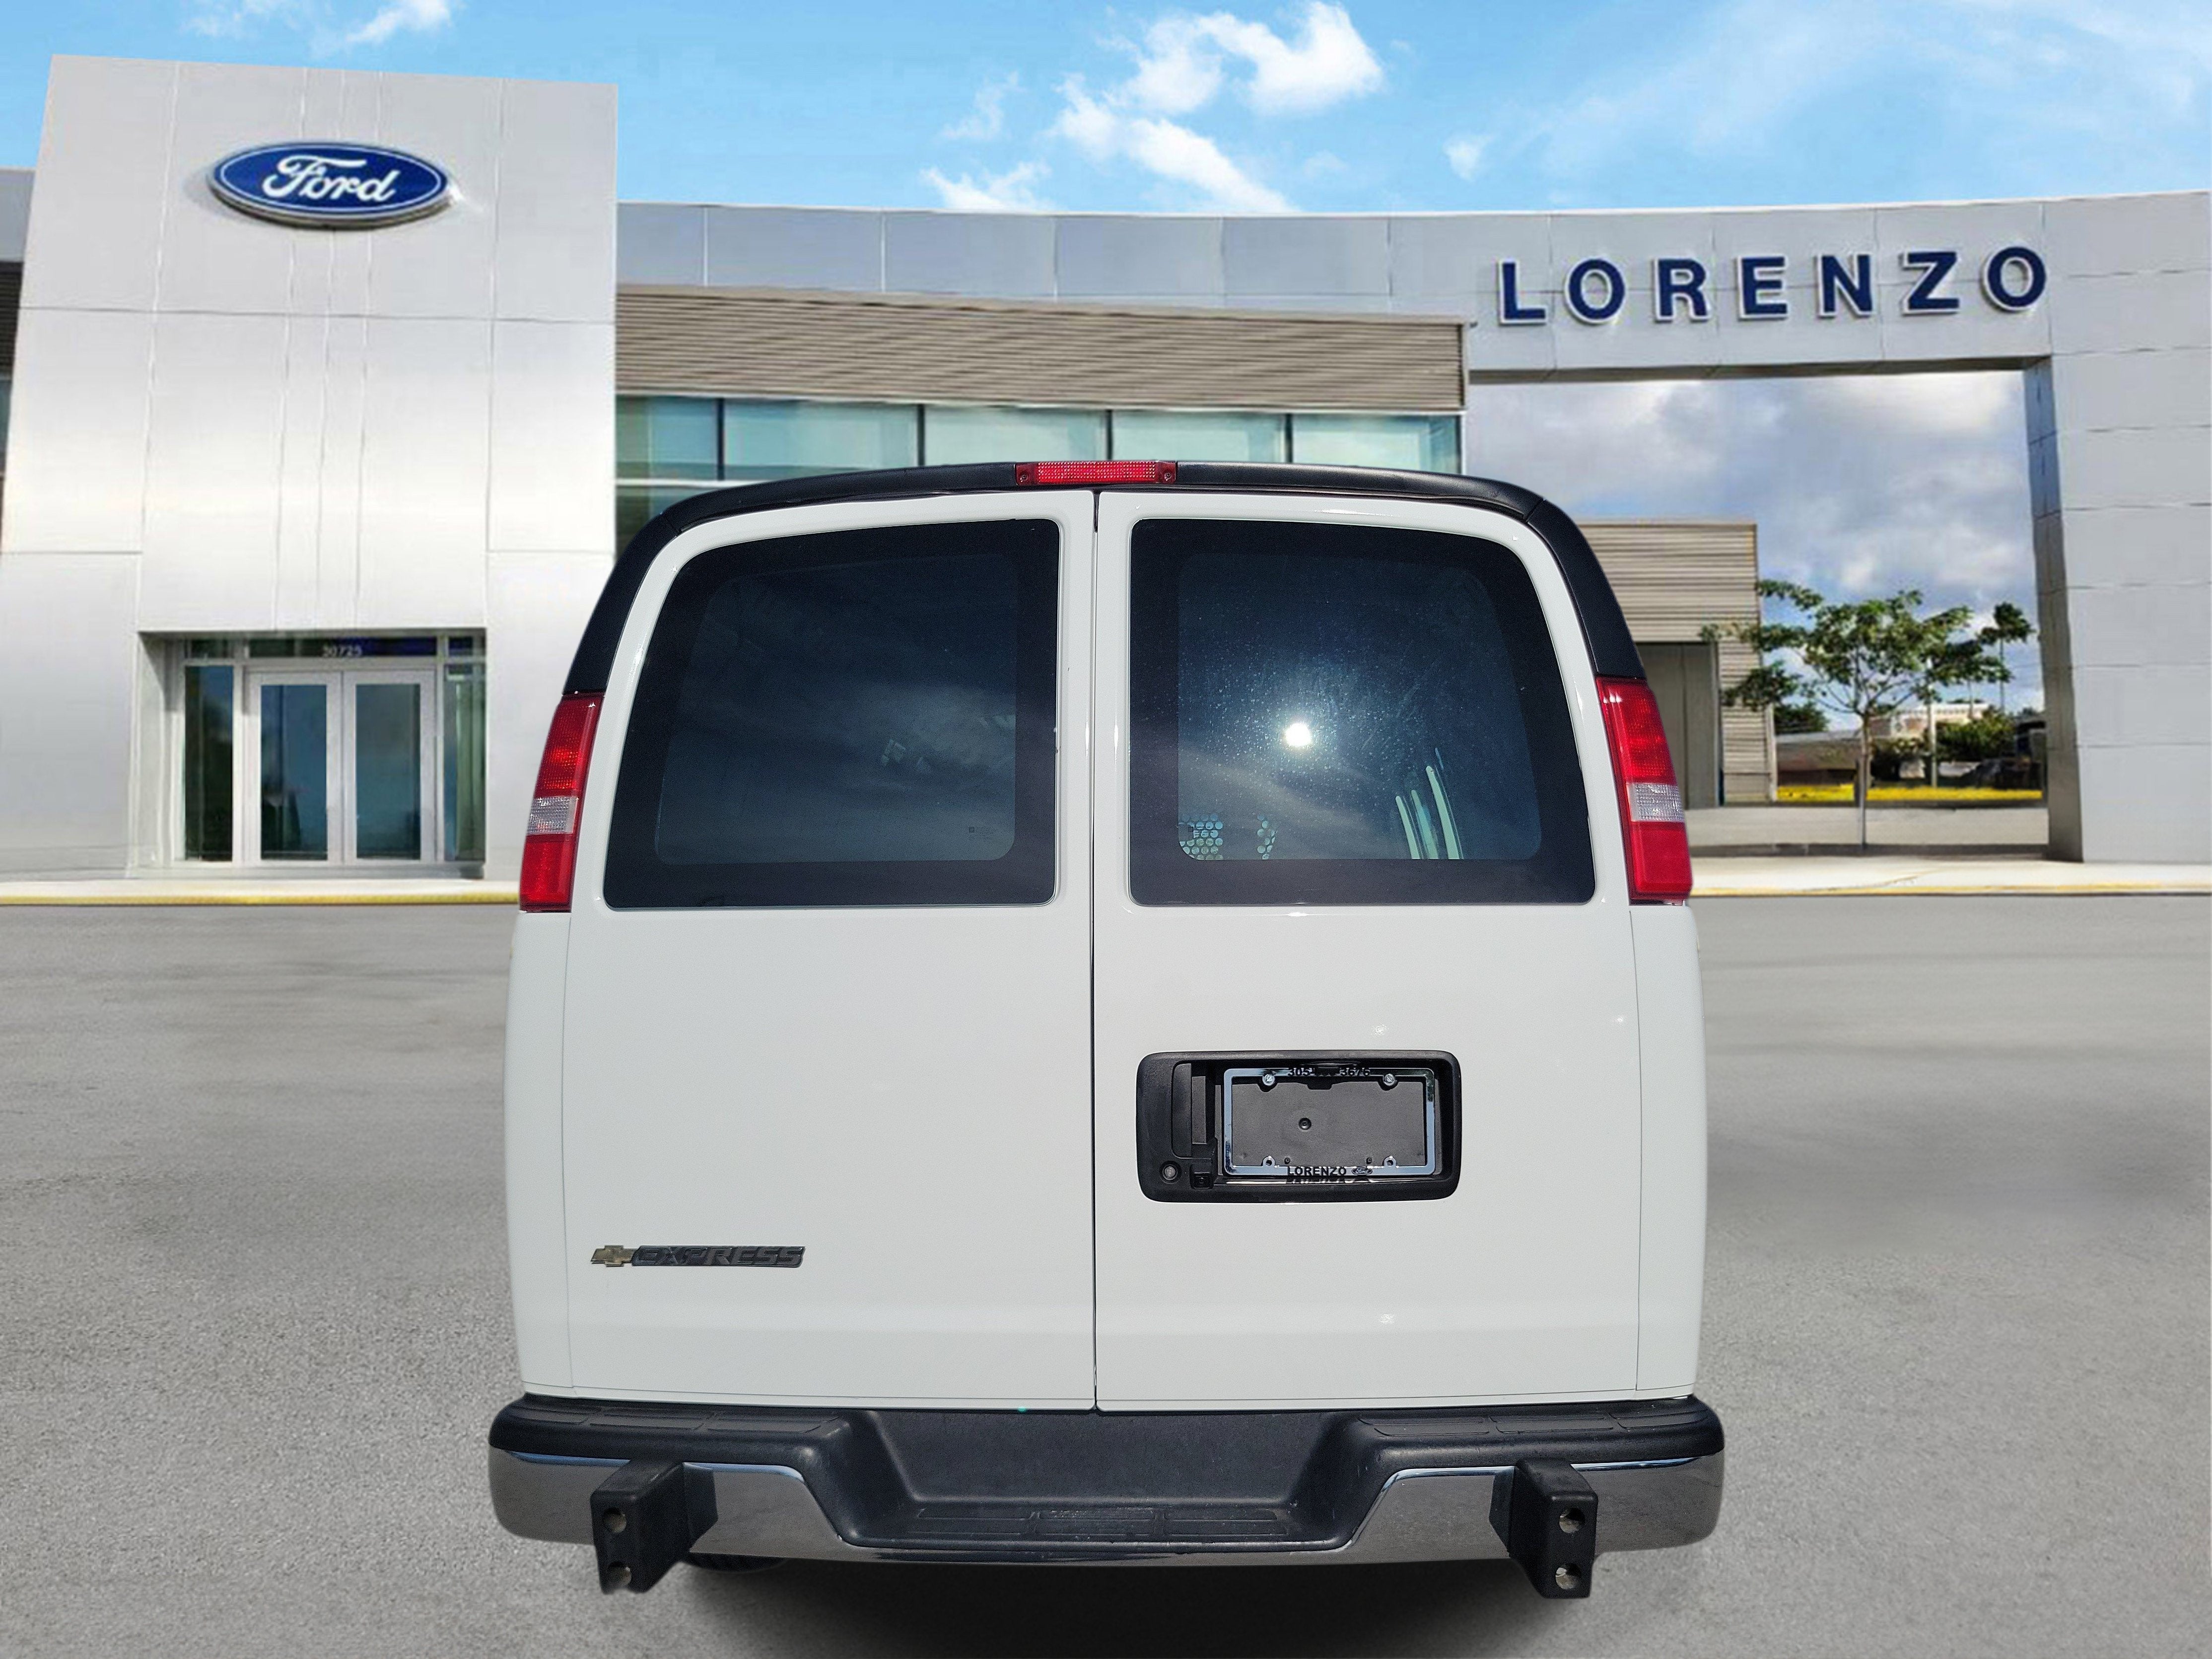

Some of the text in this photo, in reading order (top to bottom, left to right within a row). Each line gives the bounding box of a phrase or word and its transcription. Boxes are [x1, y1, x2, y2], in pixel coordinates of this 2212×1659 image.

[263, 154, 400, 202] Ford
[1498, 246, 2046, 324] LORENZO
[1288, 1166, 1347, 1176] LORENZO
[632, 1246, 805, 1268] EXPRESS
